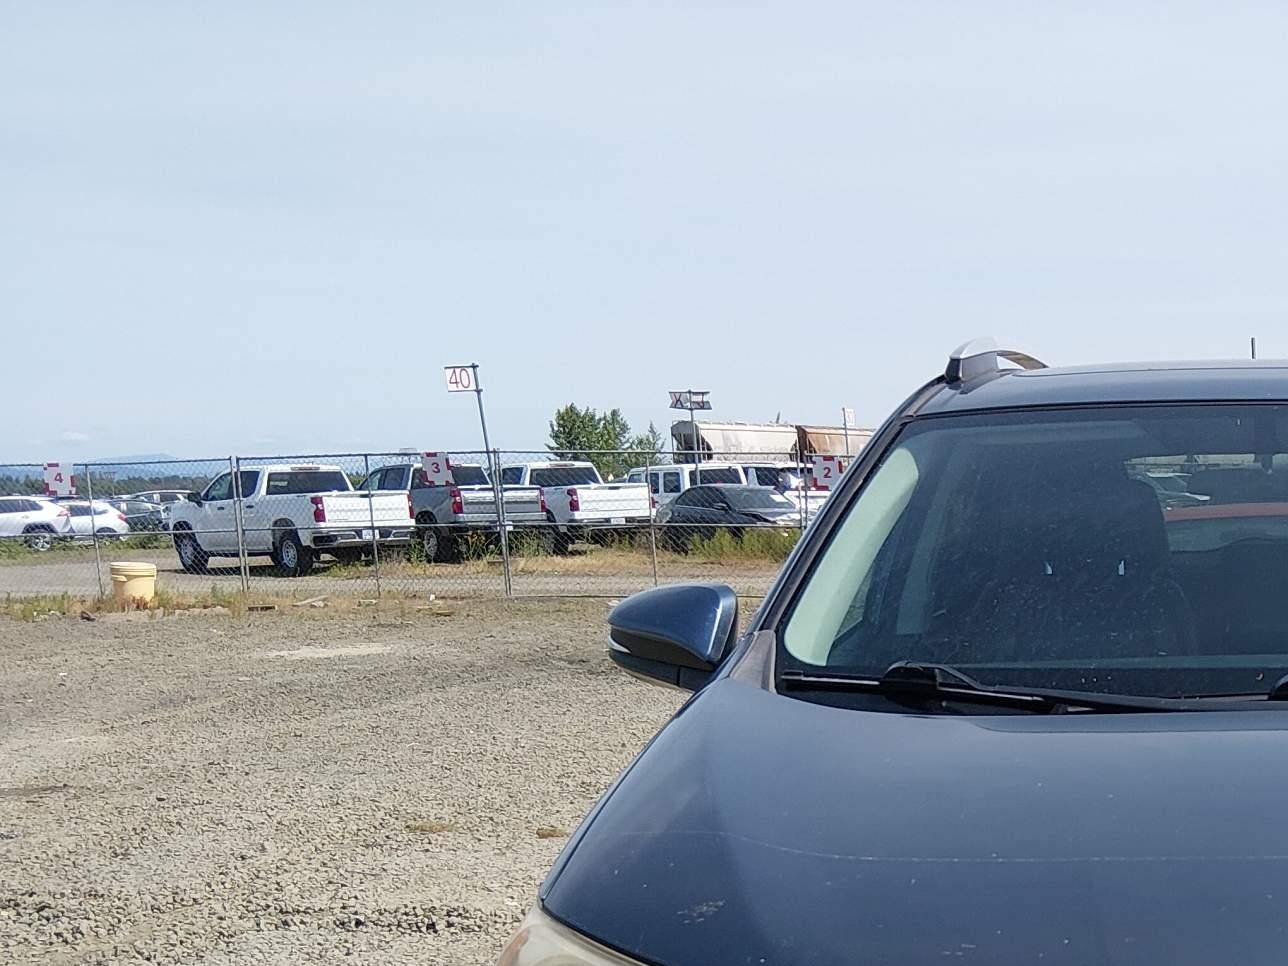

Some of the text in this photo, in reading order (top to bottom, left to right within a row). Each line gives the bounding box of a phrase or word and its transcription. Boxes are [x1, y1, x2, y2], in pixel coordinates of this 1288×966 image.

[449, 367, 471, 388] 40
[431, 462, 441, 473] 3
[823, 466, 832, 479] 2
[54, 472, 63, 483] 4
